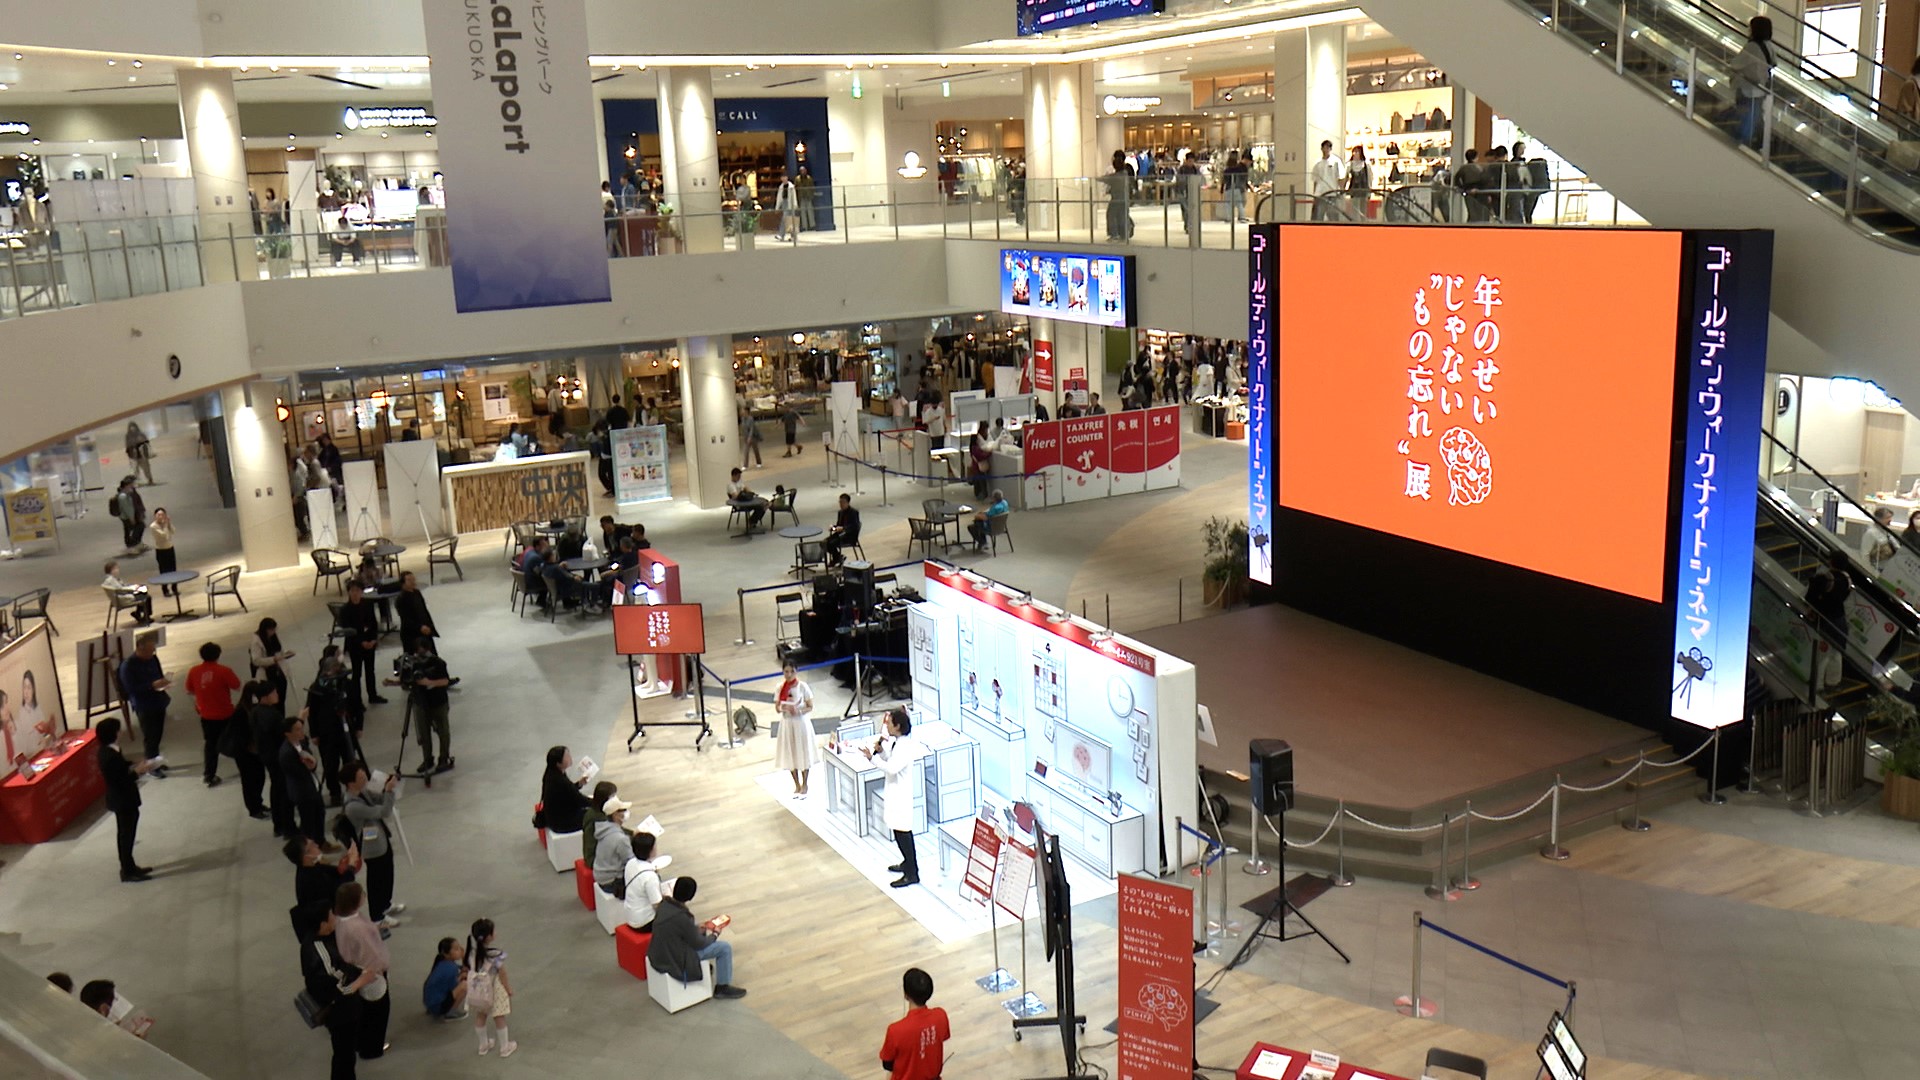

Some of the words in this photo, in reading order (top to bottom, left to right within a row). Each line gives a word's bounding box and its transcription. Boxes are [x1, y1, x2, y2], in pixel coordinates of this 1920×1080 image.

[532, 0, 552, 94] ピングパーク
[490, 0, 530, 154] aLaport
[729, 111, 757, 120] CALL
[1440, 274, 1466, 415] じゃない
[1472, 274, 1503, 424] 年のせい
[1030, 438, 1056, 450] Here
[1066, 433, 1104, 444] COUNTER
[1084, 420, 1104, 431] FREE
